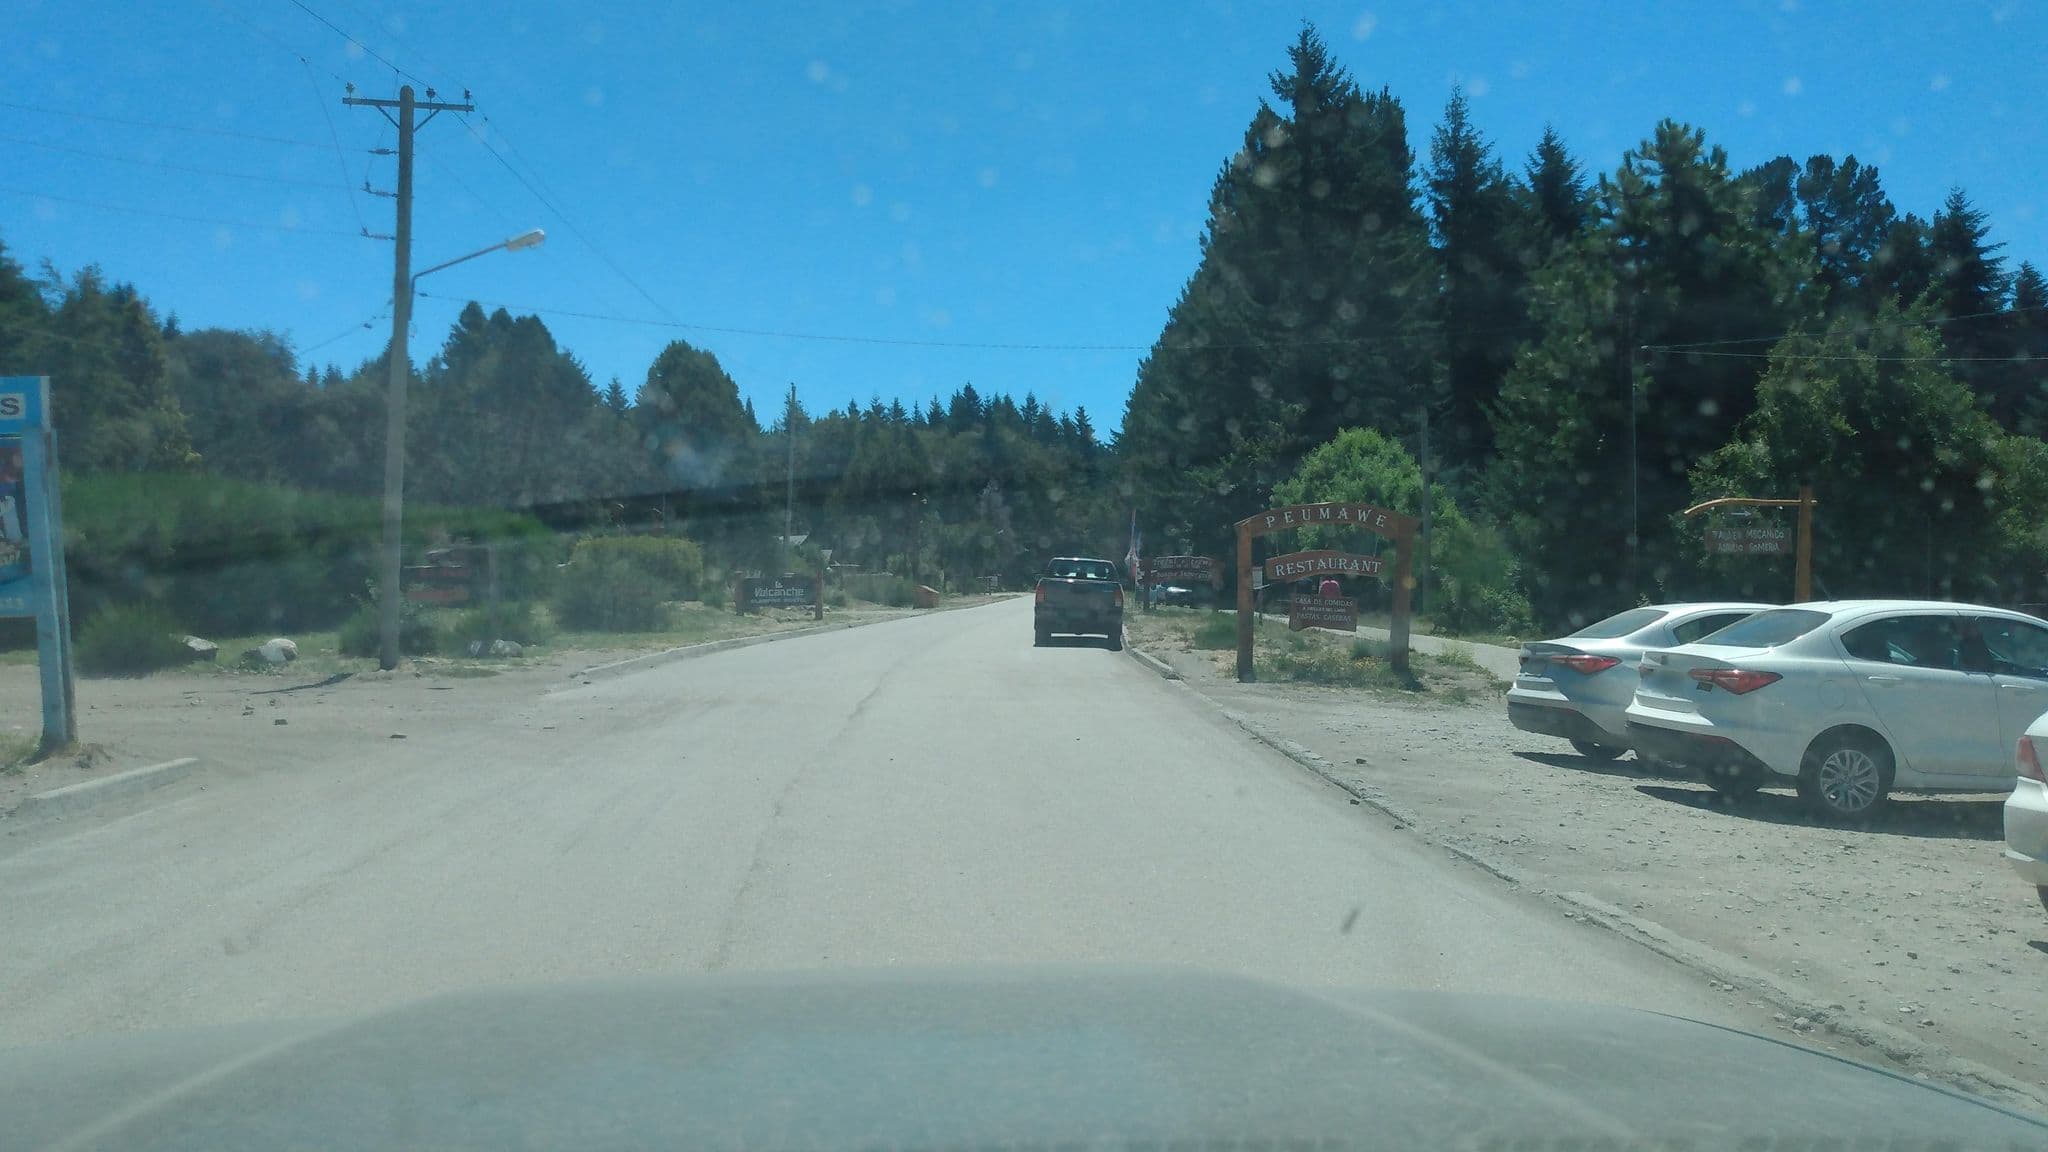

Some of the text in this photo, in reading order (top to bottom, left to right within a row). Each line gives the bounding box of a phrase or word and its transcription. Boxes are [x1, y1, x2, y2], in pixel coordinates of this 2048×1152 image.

[1265, 507, 1388, 529] PEUMAWE
[1275, 557, 1382, 577] RESTAURANT
[754, 587, 804, 597] Volcanche
[1324, 599, 1353, 607] COMIDAS
